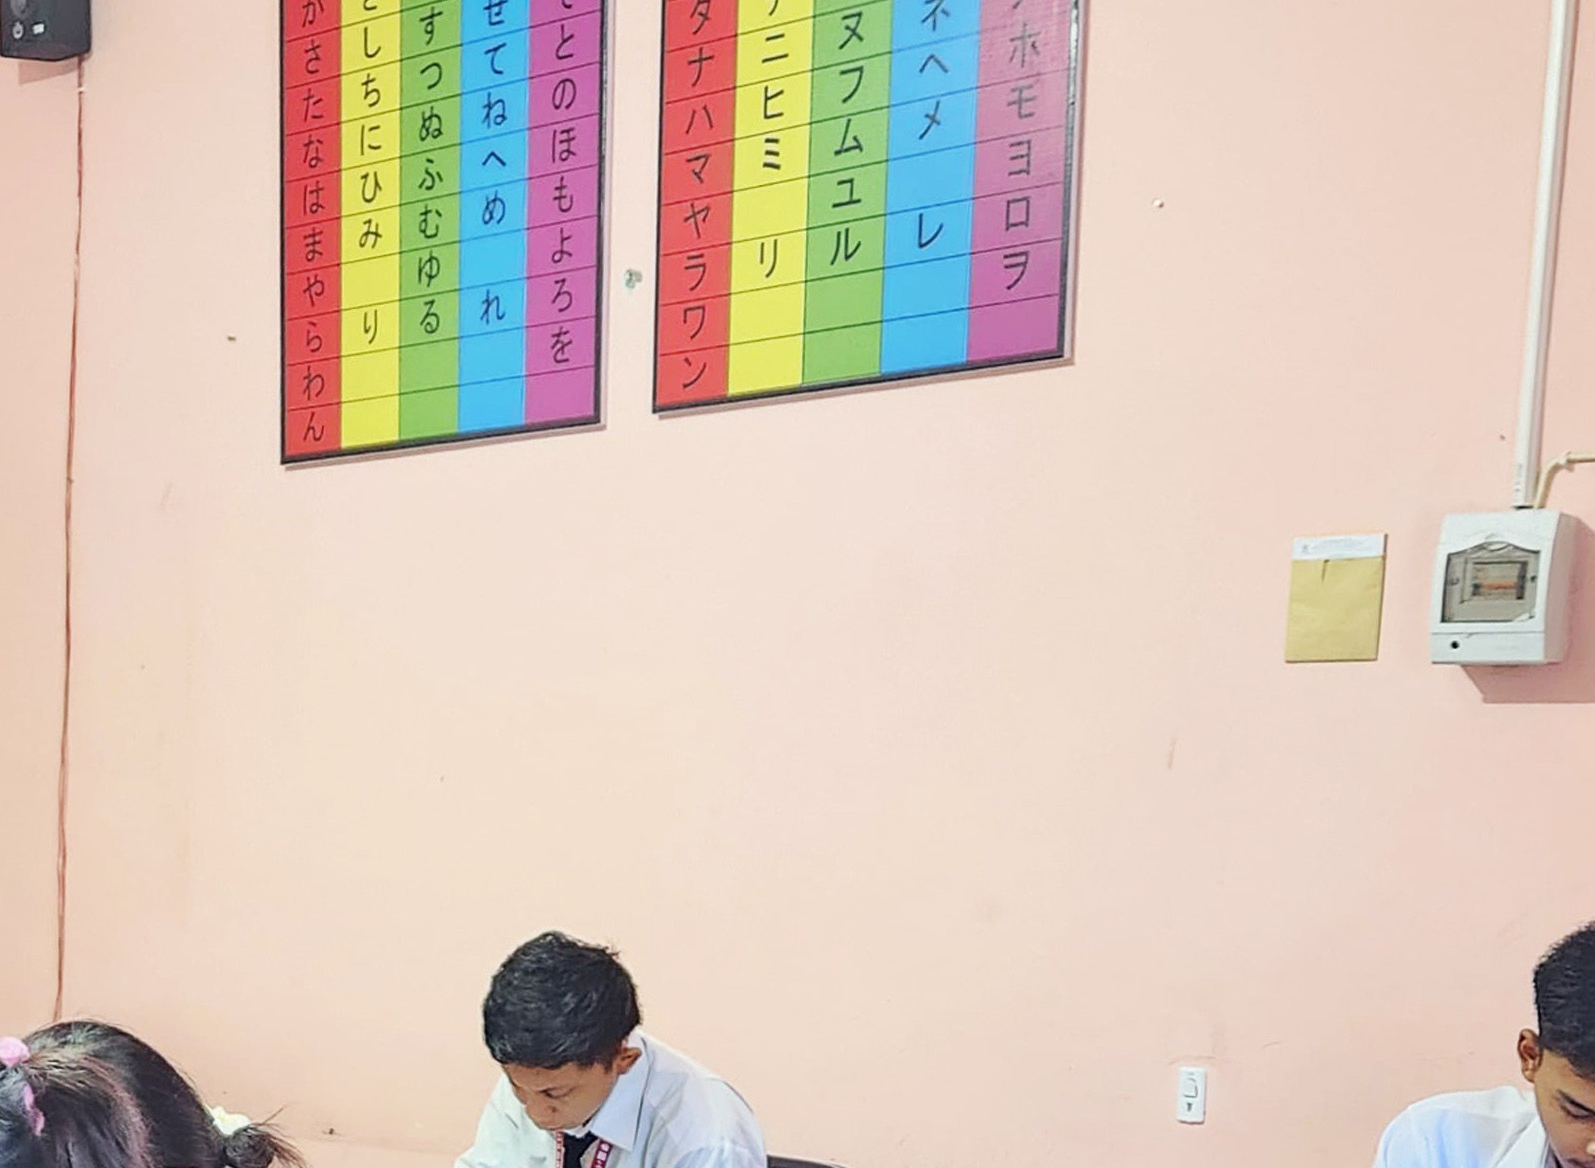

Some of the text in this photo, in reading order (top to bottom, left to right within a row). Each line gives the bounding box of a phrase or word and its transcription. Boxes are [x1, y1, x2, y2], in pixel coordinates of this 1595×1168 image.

[303, 24, 575, 121] た ち つ て と
[305, 38, 322, 74] さ
[364, 26, 382, 58] し
[419, 7, 443, 44] す
[685, 104, 713, 134] ハ
[763, 85, 784, 120] ヒ
[839, 66, 864, 103] フ
[1009, 21, 1040, 69] ホ
[687, 46, 714, 87] ナ
[838, 11, 864, 49] ヌ
[304, 78, 577, 168] な に ぬ ね の
[685, 82, 1036, 184] マ ミ ム メ モ
[303, 181, 324, 214] は
[360, 171, 382, 204] ひ
[418, 157, 443, 190] ふ
[551, 127, 577, 162] ほ
[683, 139, 1031, 239] ヤ ユ ヨ
[304, 176, 575, 262] ま み む め も
[684, 254, 706, 291] ラ
[830, 227, 862, 265] ル
[918, 213, 943, 249] レ
[302, 228, 573, 306] や ゆ よ
[682, 251, 1029, 340] ワ ヲ
[306, 322, 323, 352] ら
[419, 300, 440, 334] る
[481, 289, 505, 325] れ
[551, 278, 573, 312] ろ
[302, 326, 573, 399] わ を
[682, 357, 706, 388] ン
[302, 412, 325, 442] ん
